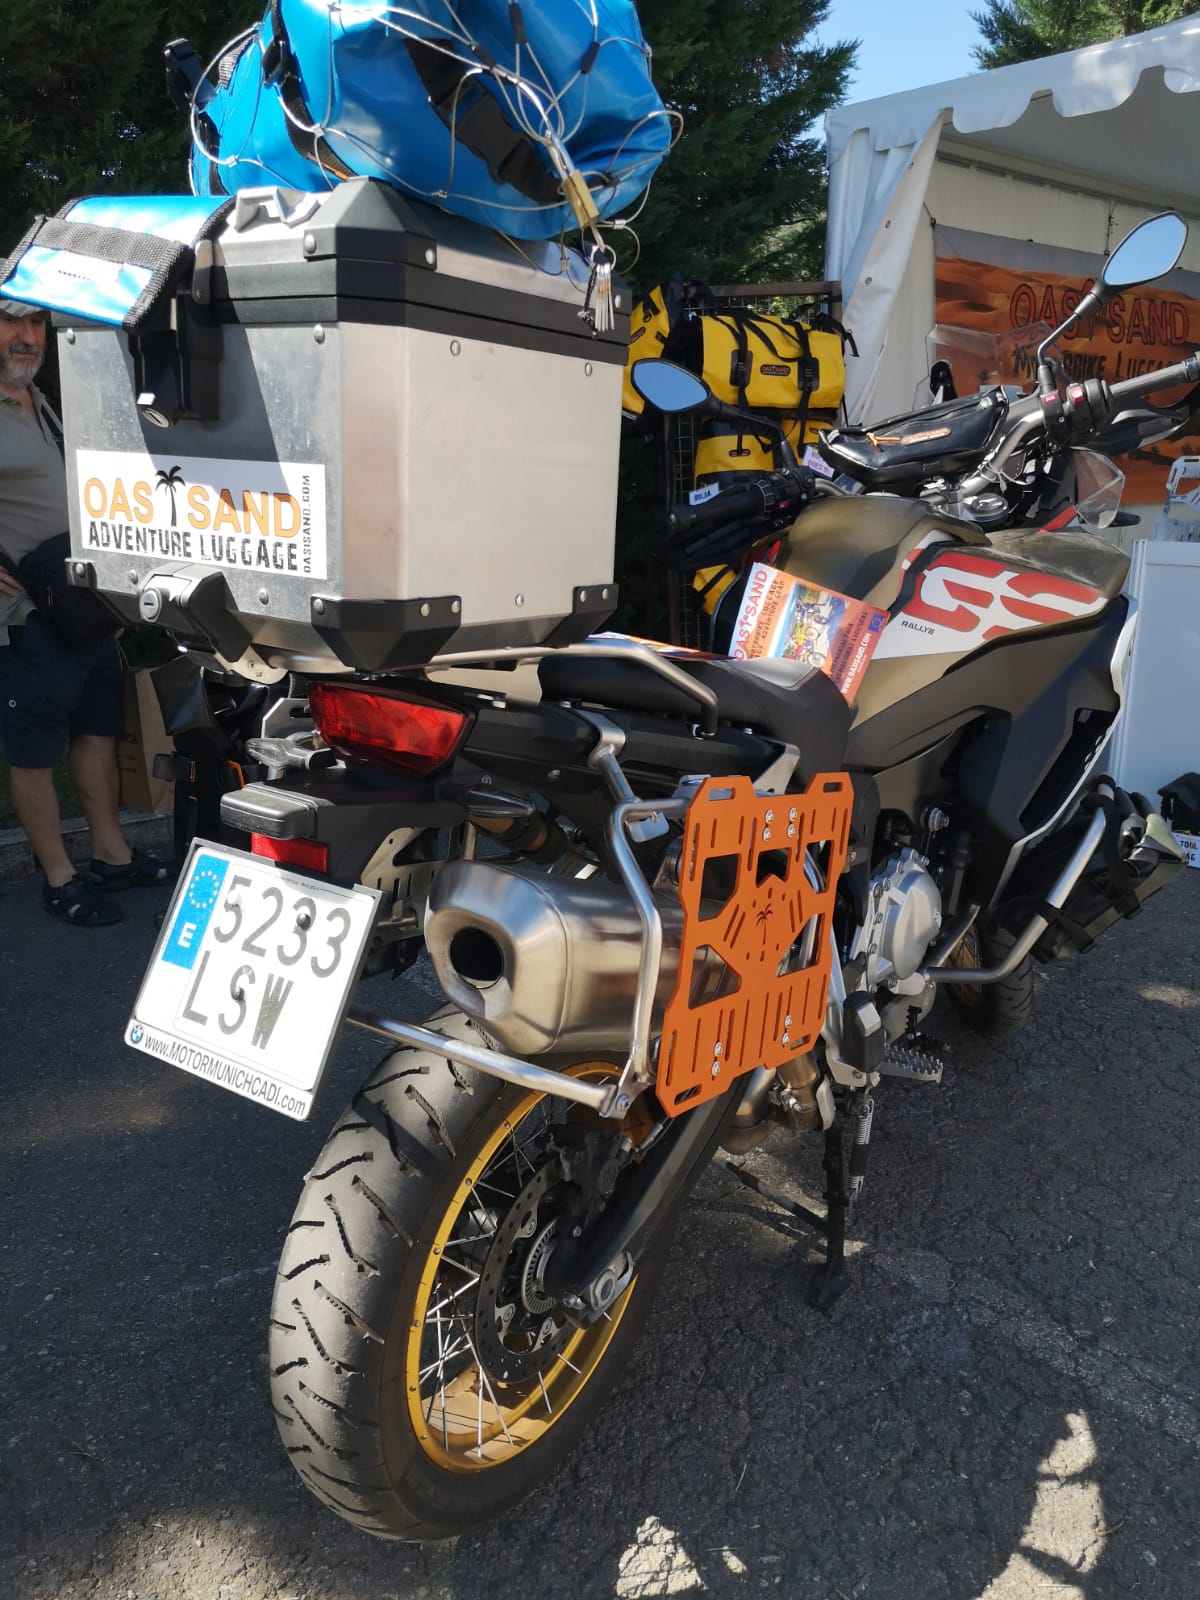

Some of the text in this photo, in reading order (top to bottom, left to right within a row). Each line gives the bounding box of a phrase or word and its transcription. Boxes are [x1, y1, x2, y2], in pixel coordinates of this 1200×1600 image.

[1107, 296, 1190, 346] SAND
[187, 486, 301, 538] SAND
[302, 476, 312, 573] OASISAND.COM
[89, 521, 298, 572] ADVENTURE LUGGAGE
[901, 620, 935, 635] RALLYE
[178, 922, 197, 948] E
[213, 875, 352, 979] 5233
[182, 950, 294, 1050] LSW
[145, 1035, 306, 1116] www.MOTORMUNICHCADI.com
